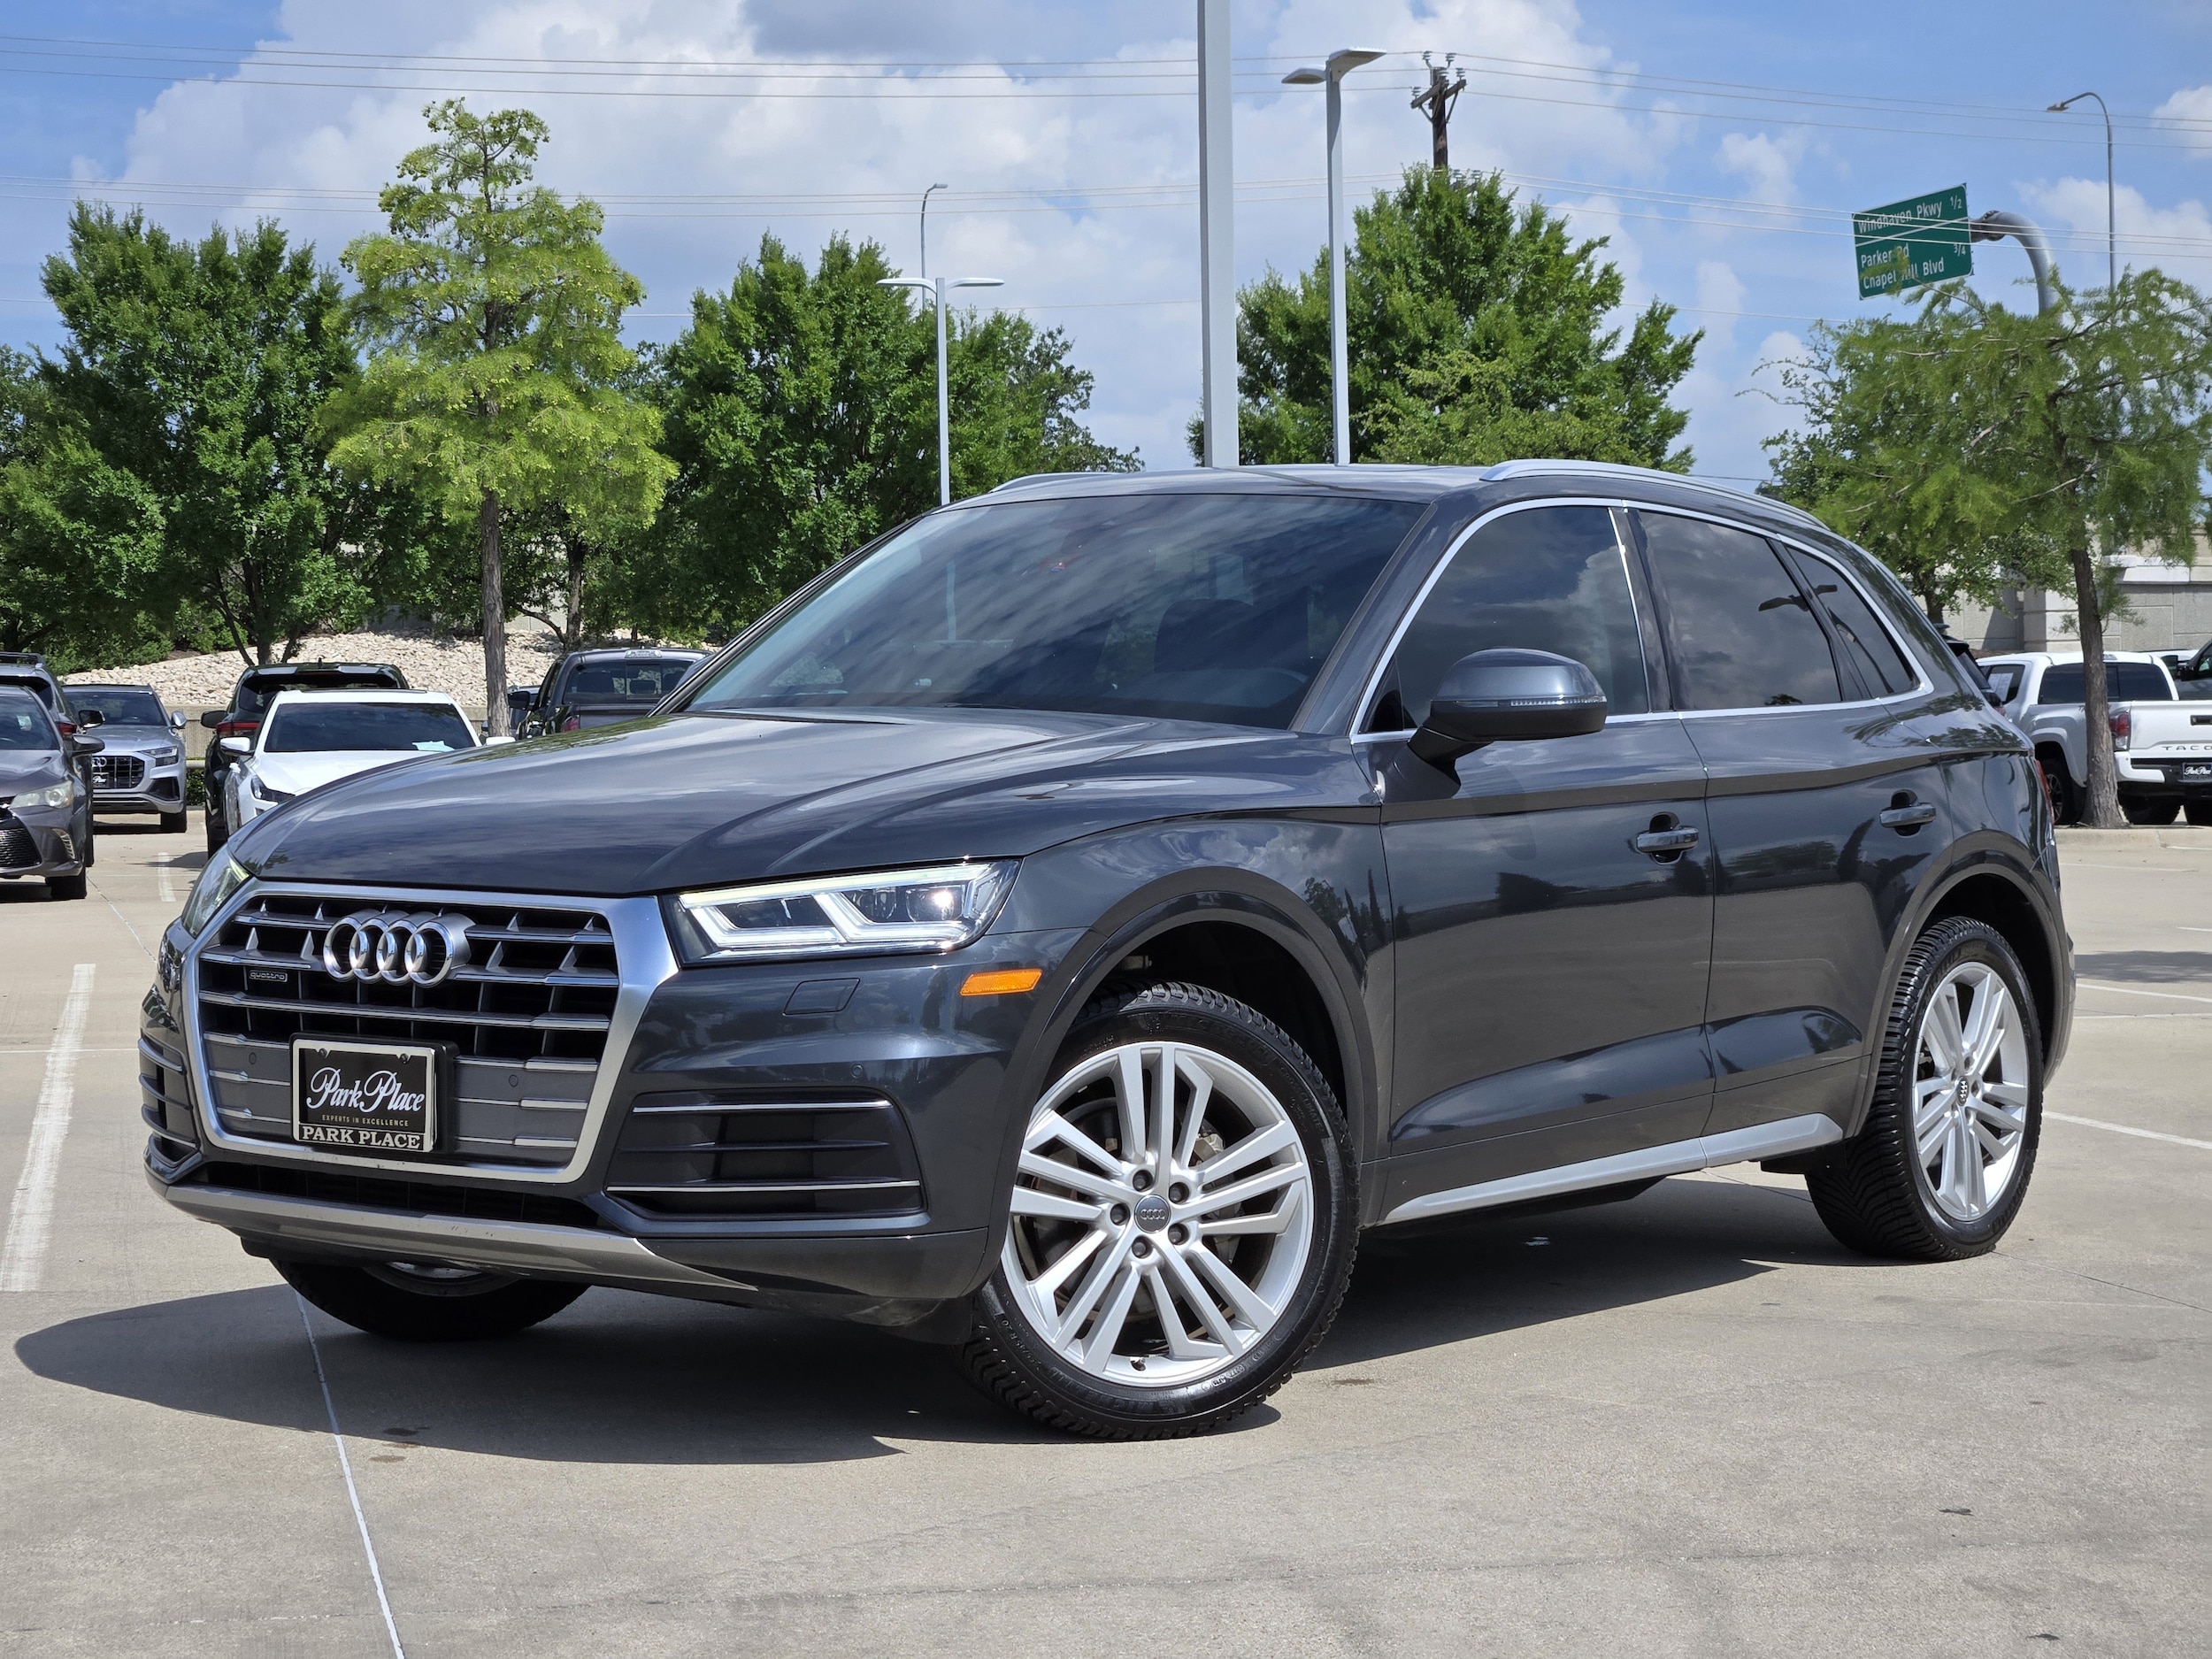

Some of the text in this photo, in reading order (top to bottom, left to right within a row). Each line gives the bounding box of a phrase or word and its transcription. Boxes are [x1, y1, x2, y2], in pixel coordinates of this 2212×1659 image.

[1858, 195, 1962, 234] Windhaven Pkwy 1/2
[1861, 250, 1893, 268] Parker
[1954, 242, 1966, 257] 3/4
[1923, 257, 1945, 276] Blvd
[306, 1066, 425, 1113] Park Place
[321, 1114, 350, 1124] EXPERTS
[362, 1118, 409, 1127] EXCELLENCE
[302, 1125, 421, 1149] PARK PLACE
